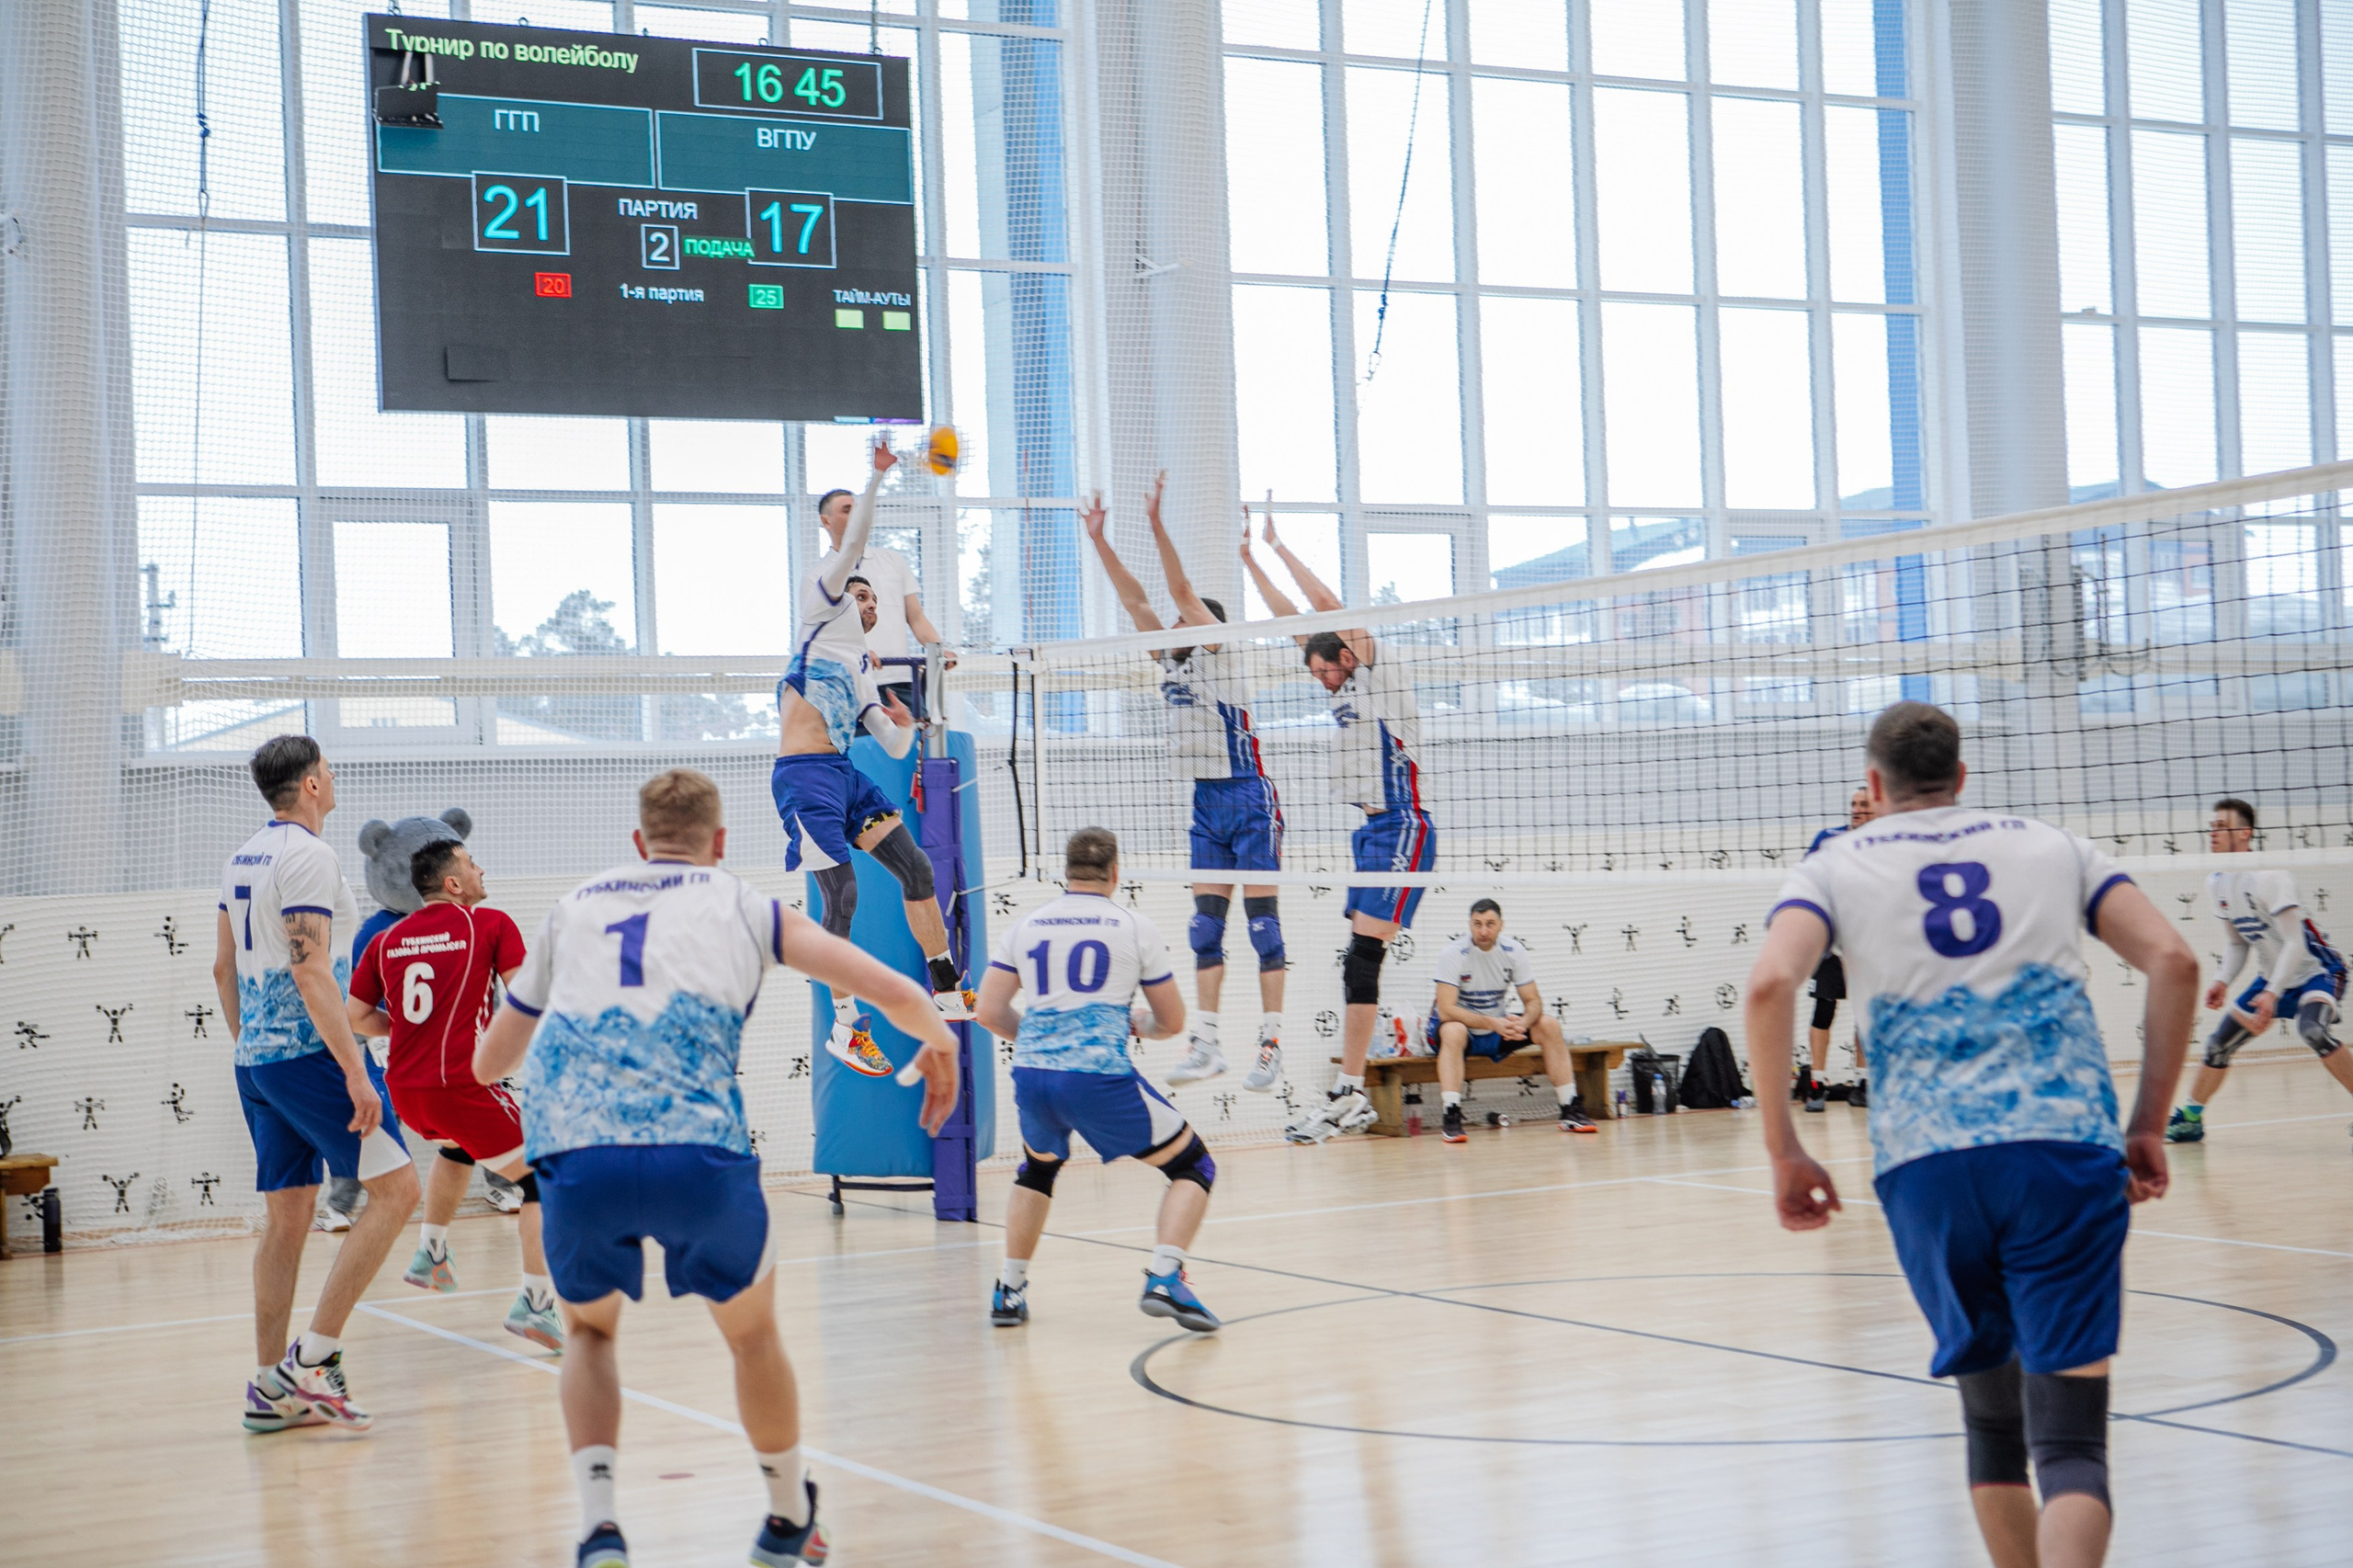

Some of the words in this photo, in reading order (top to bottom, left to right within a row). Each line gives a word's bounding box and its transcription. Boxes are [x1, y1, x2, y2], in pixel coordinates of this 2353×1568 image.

[384, 28, 474, 61] Турнир
[480, 40, 509, 60] по
[514, 43, 639, 74] волейболу
[733, 62, 783, 103] 16
[793, 67, 847, 108] 45
[494, 108, 540, 132] ГГП
[756, 127, 817, 151] ВГПУ
[483, 184, 549, 241] 21
[618, 198, 699, 221] ПАРТИЯ
[759, 200, 824, 255] 17
[649, 232, 670, 262] 2
[684, 237, 756, 259] ПОДАЧА
[541, 277, 566, 295] 20
[619, 282, 645, 300] 1-я
[647, 286, 705, 305] партия
[755, 289, 778, 305] 25
[832, 288, 912, 307] ТАЙМ-АУТЫ
[234, 885, 253, 950] 7
[1917, 861, 2002, 958] 8
[605, 911, 651, 987] 1
[1027, 939, 1110, 996] 10
[403, 961, 436, 1025] 6
